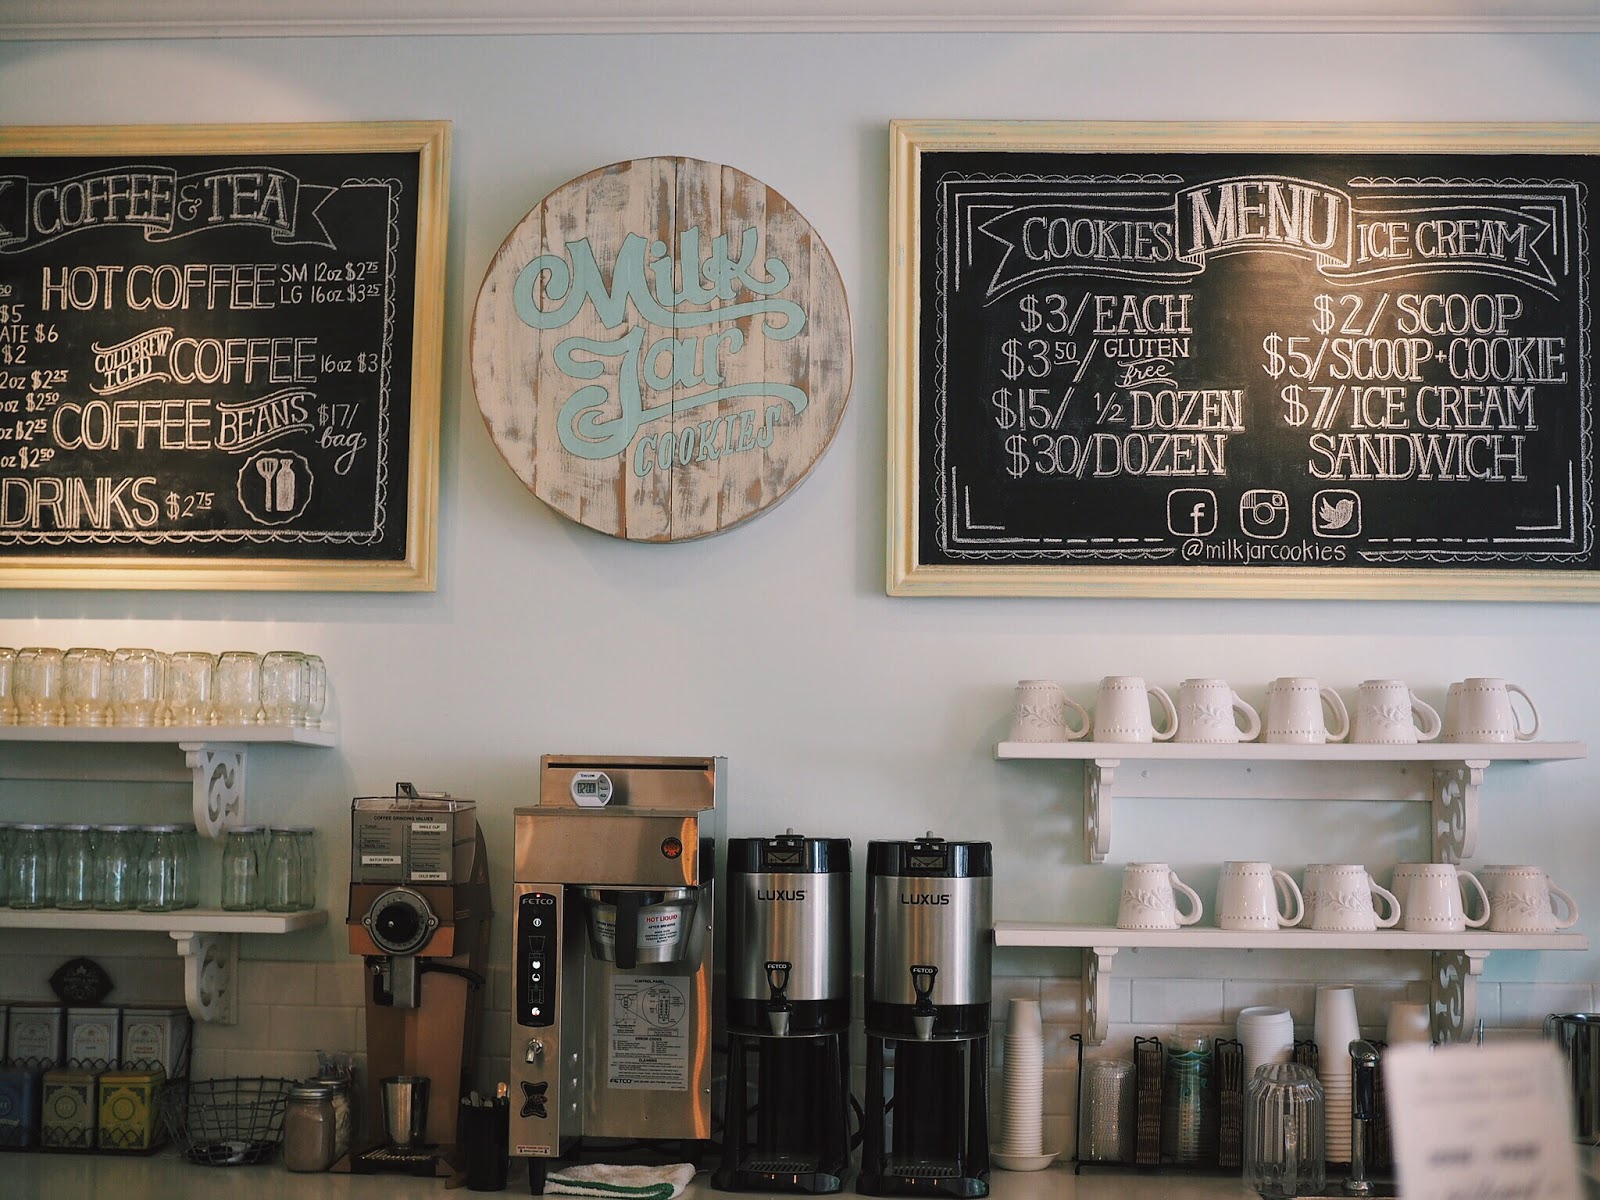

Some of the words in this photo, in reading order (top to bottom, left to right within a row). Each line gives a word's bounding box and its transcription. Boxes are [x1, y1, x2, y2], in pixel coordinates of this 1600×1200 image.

[33, 174, 173, 234] COFFEE
[177, 182, 202, 221] &
[204, 173, 289, 227] TEA
[1022, 216, 1174, 263] COOKIES
[1187, 181, 1342, 253] MENU
[1356, 221, 1412, 264] ICE
[1414, 219, 1530, 265] CREAM
[42, 265, 123, 311] HOT
[126, 264, 276, 310] COFFEE
[280, 263, 308, 283] SM
[513, 225, 807, 340] Milk
[0, 304, 24, 324] $5
[280, 286, 303, 304] LG
[1397, 293, 1524, 336] SCOOP
[34, 323, 59, 344] $6
[94, 347, 131, 374] COLD
[131, 332, 169, 362] BREW
[1103, 337, 1190, 358] GLUTEN
[103, 356, 153, 389] ICED
[169, 337, 318, 384] COFFEE
[320, 353, 353, 373] 16oz
[357, 351, 379, 373] $3
[1119, 362, 1173, 386] free
[553, 325, 808, 459] Jar
[1129, 389, 1246, 432] DOZEN
[1350, 386, 1410, 430] ICE
[1416, 385, 1539, 431] CREAM
[53, 400, 212, 450] COFFEE
[219, 394, 309, 446] BEANS
[633, 404, 782, 477] COOKIES
[315, 426, 367, 476] bag
[1308, 433, 1528, 482] SANDWICH
[1, 477, 159, 529] DRINKS
[1181, 538, 1347, 565] @milkjarcookies
[757, 889, 806, 901] LUXUS
[901, 893, 951, 905] LUXUS
[646, 915, 659, 923] HOT
[659, 914, 678, 923] LIQUID
